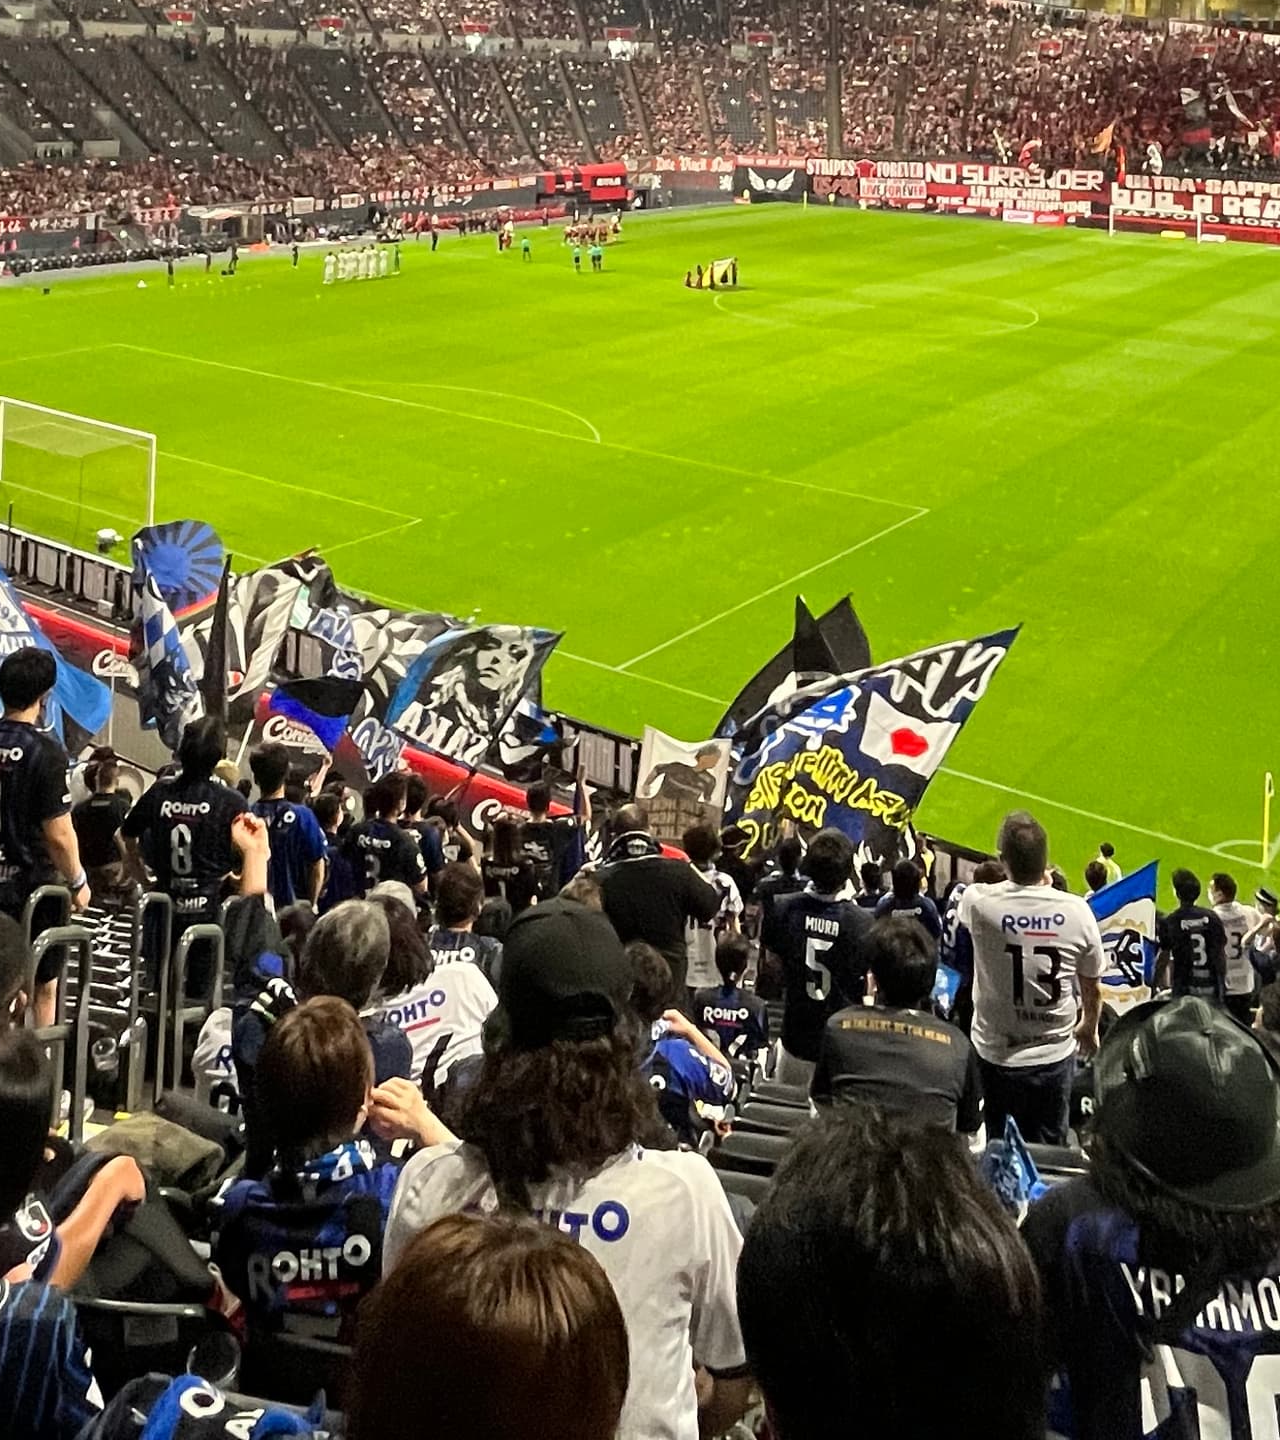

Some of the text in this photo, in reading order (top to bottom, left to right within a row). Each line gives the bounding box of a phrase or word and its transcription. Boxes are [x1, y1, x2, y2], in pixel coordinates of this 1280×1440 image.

[806, 158, 856, 177] STRIPES
[877, 161, 924, 178] FOREVER
[925, 161, 957, 186] NO
[160, 800, 211, 818] ROHTO
[170, 823, 192, 875] 8
[804, 915, 840, 937] MIURA
[1002, 913, 1065, 935] ROHTO
[431, 945, 476, 962] OHTO
[1189, 933, 1207, 966] 3
[805, 937, 834, 1001] 5
[1004, 943, 1062, 1007] 13
[703, 1006, 749, 1023] ROHTO
[247, 1233, 372, 1303] ROHTO
